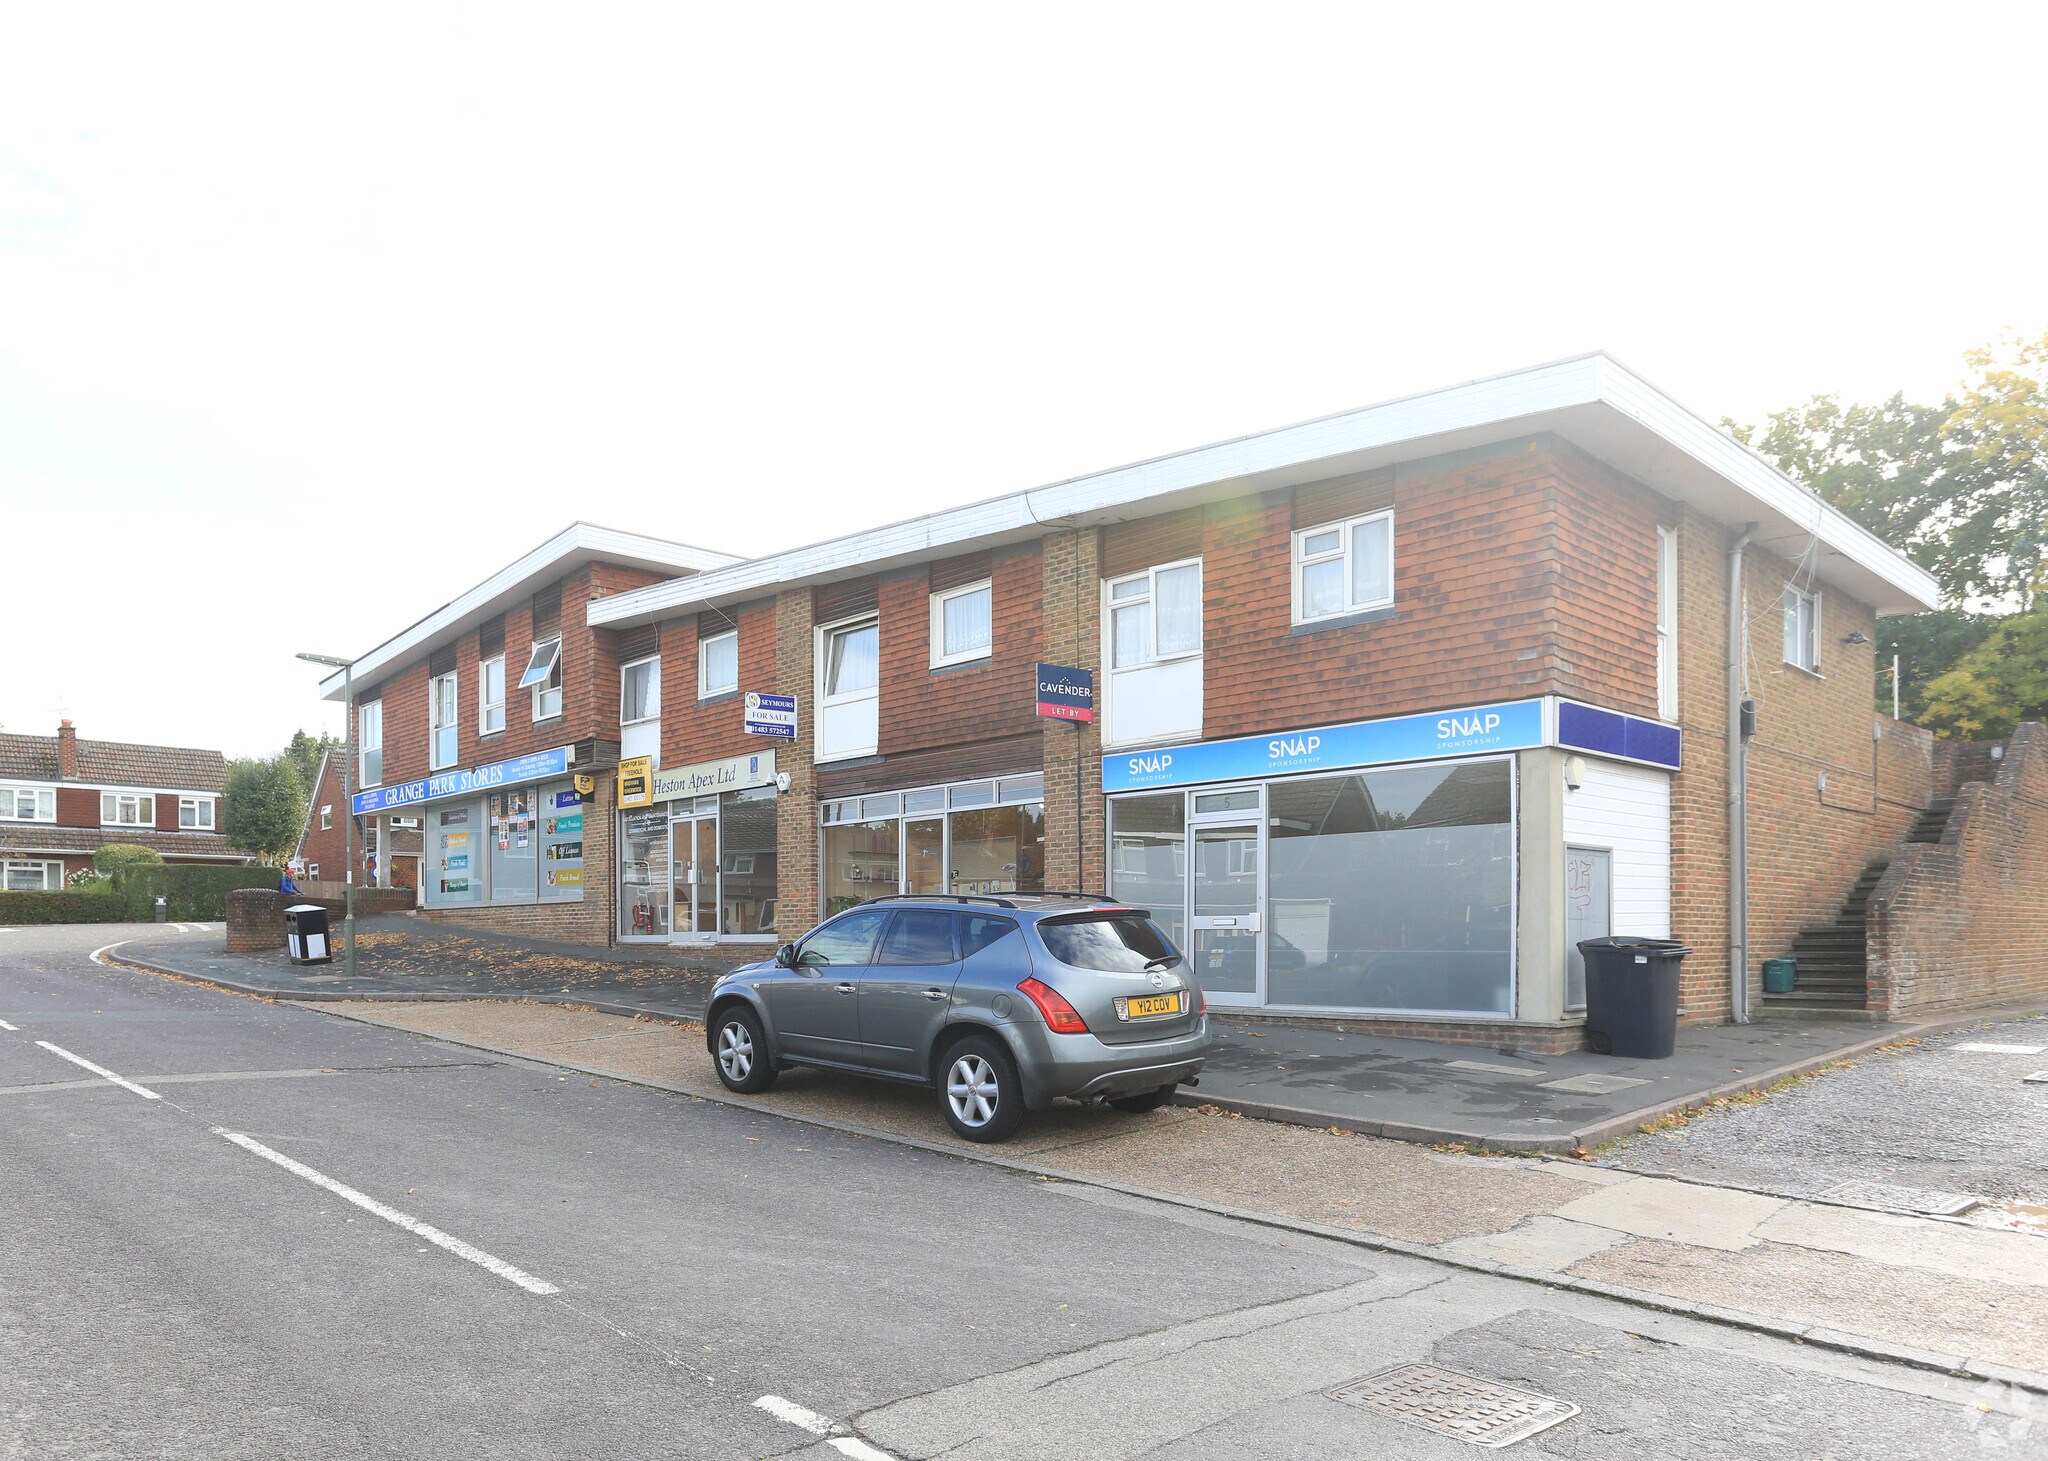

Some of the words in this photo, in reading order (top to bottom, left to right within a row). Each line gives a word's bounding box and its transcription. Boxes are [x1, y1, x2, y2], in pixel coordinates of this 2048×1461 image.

[1040, 682, 1090, 697] CAVENDER
[762, 699, 794, 708] SEYMOURS
[1437, 712, 1500, 738] SNAP
[1269, 734, 1320, 758] SNAP
[1436, 736, 1500, 749] SPONSORSHIP
[1129, 753, 1172, 775] SNAP
[1268, 757, 1320, 768] SPONSORSHIP
[385, 782, 424, 805] GRANGE
[429, 775, 456, 797] PARK
[461, 764, 503, 790] STORES
[653, 779, 686, 794] Heston
[688, 773, 714, 792] Apex
[717, 764, 736, 784] Ltd
[1129, 774, 1172, 783] SPONSORSHIP
[1224, 797, 1231, 809] 5
[1137, 1000, 1152, 1013] Y12
[1154, 998, 1170, 1011] COV
